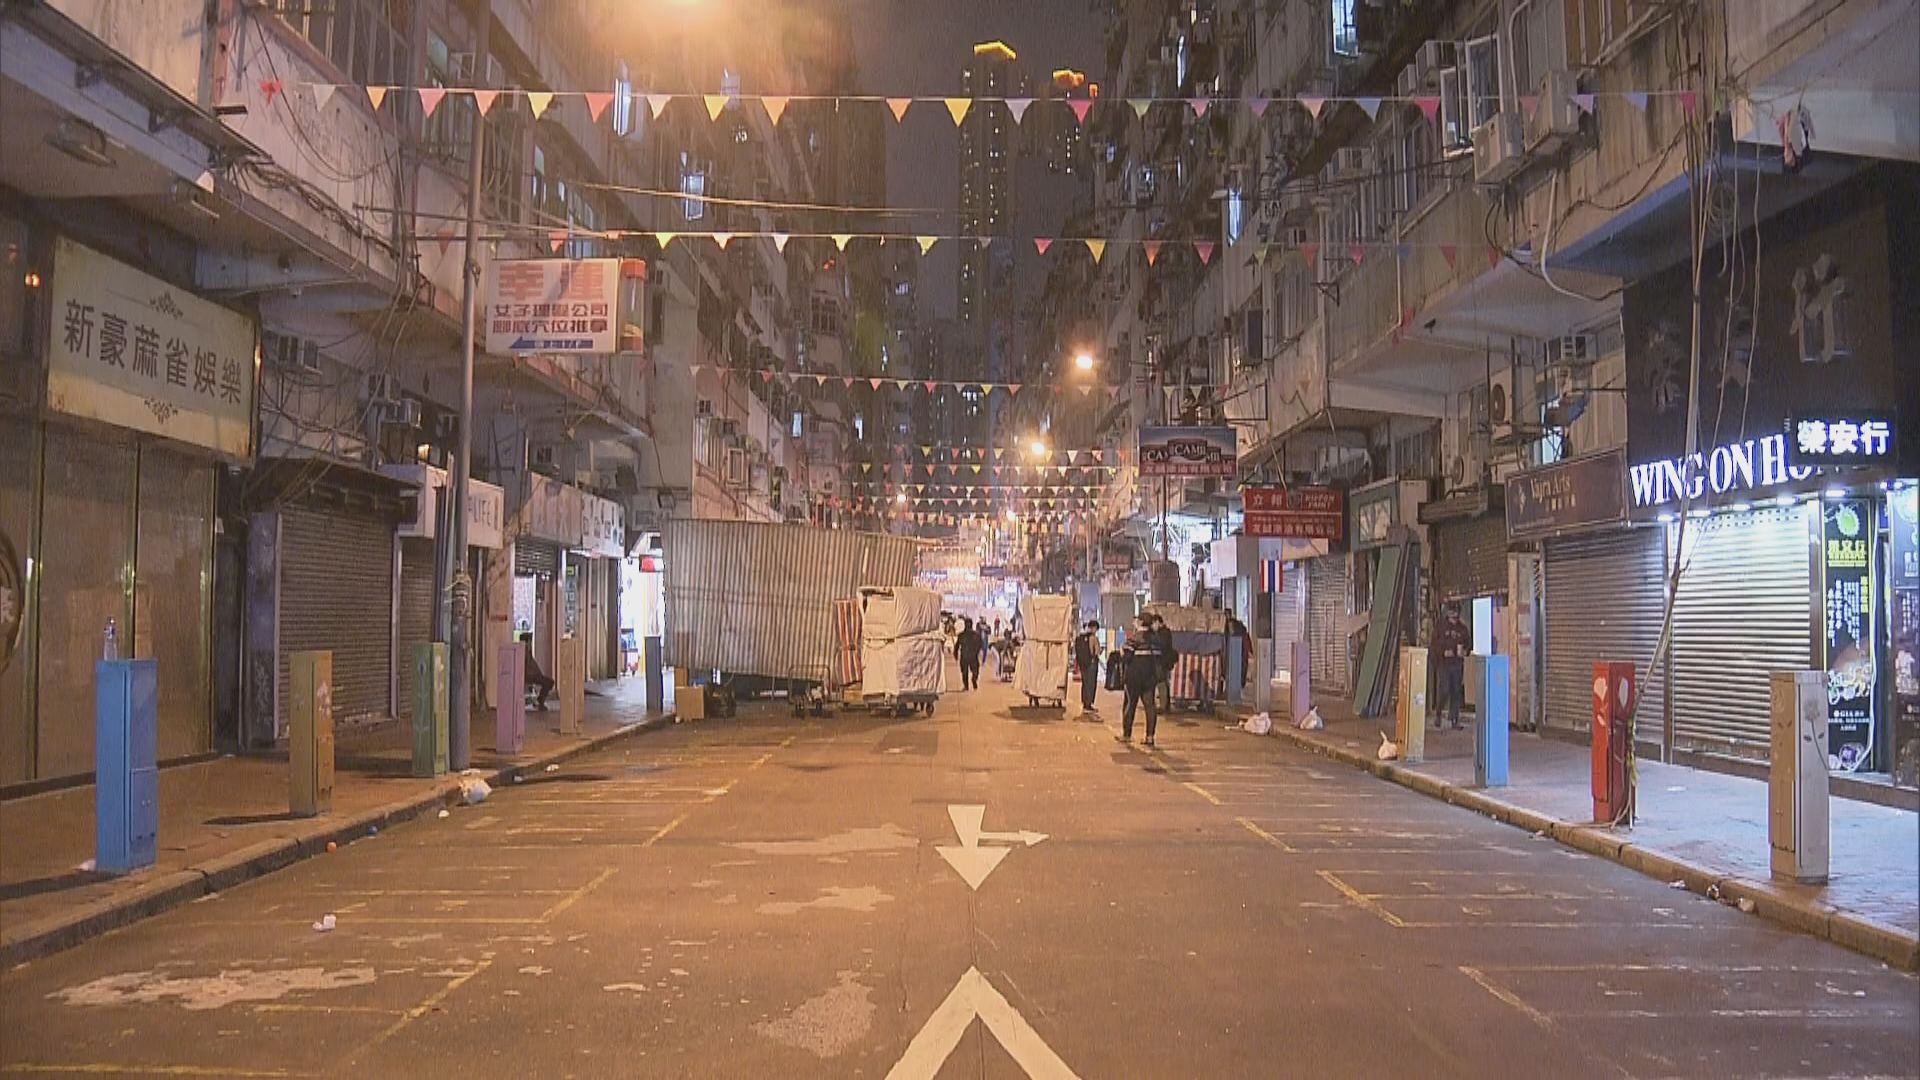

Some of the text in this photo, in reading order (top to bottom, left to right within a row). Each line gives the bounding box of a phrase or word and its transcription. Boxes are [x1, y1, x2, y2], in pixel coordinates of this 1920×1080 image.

[63, 298, 243, 405] 新豪蔴雀娛樂
[1796, 419, 1890, 456] 榮安行
[1629, 451, 1705, 508] WING
[1709, 439, 1755, 494] ON
